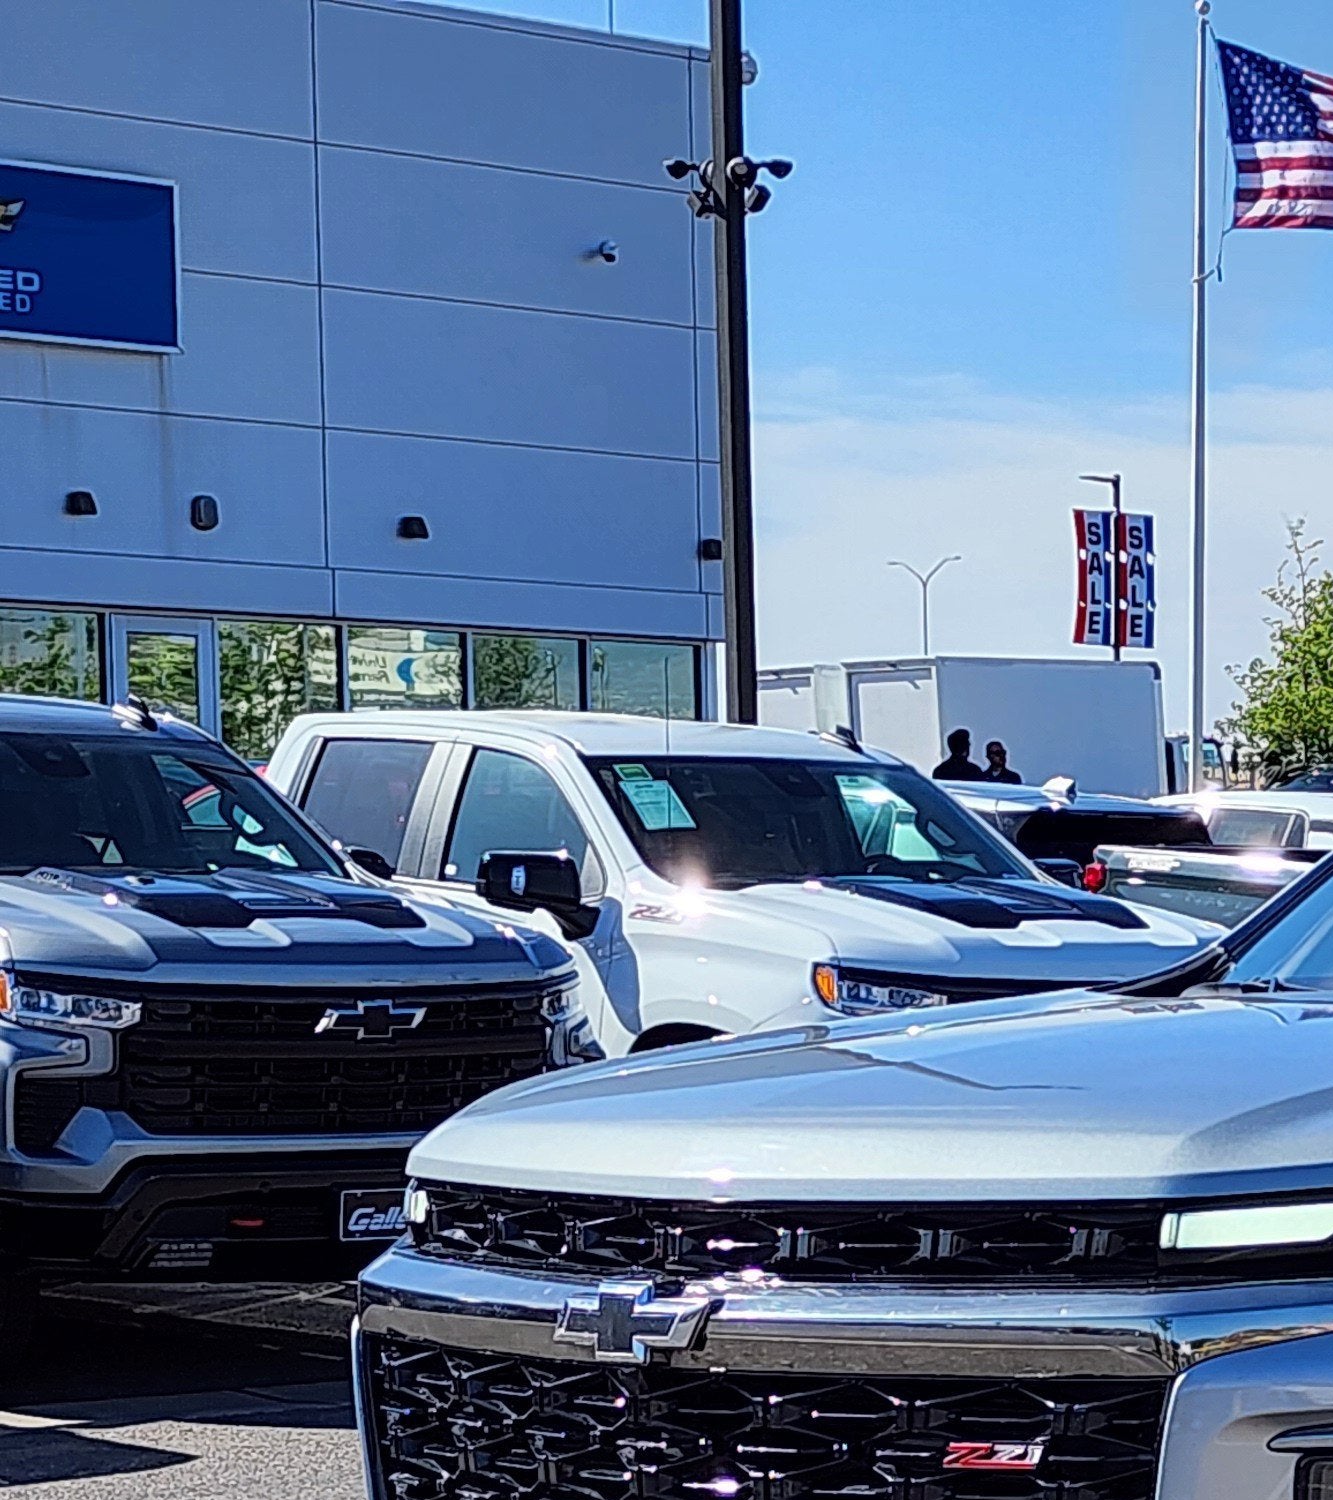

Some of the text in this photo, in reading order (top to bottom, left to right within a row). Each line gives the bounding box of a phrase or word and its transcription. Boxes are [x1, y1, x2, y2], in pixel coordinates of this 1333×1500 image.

[1087, 522, 1103, 634] SALE
[1128, 526, 1145, 638] SALE
[347, 1206, 407, 1231] Galle
[942, 1442, 1044, 1470] Z71
